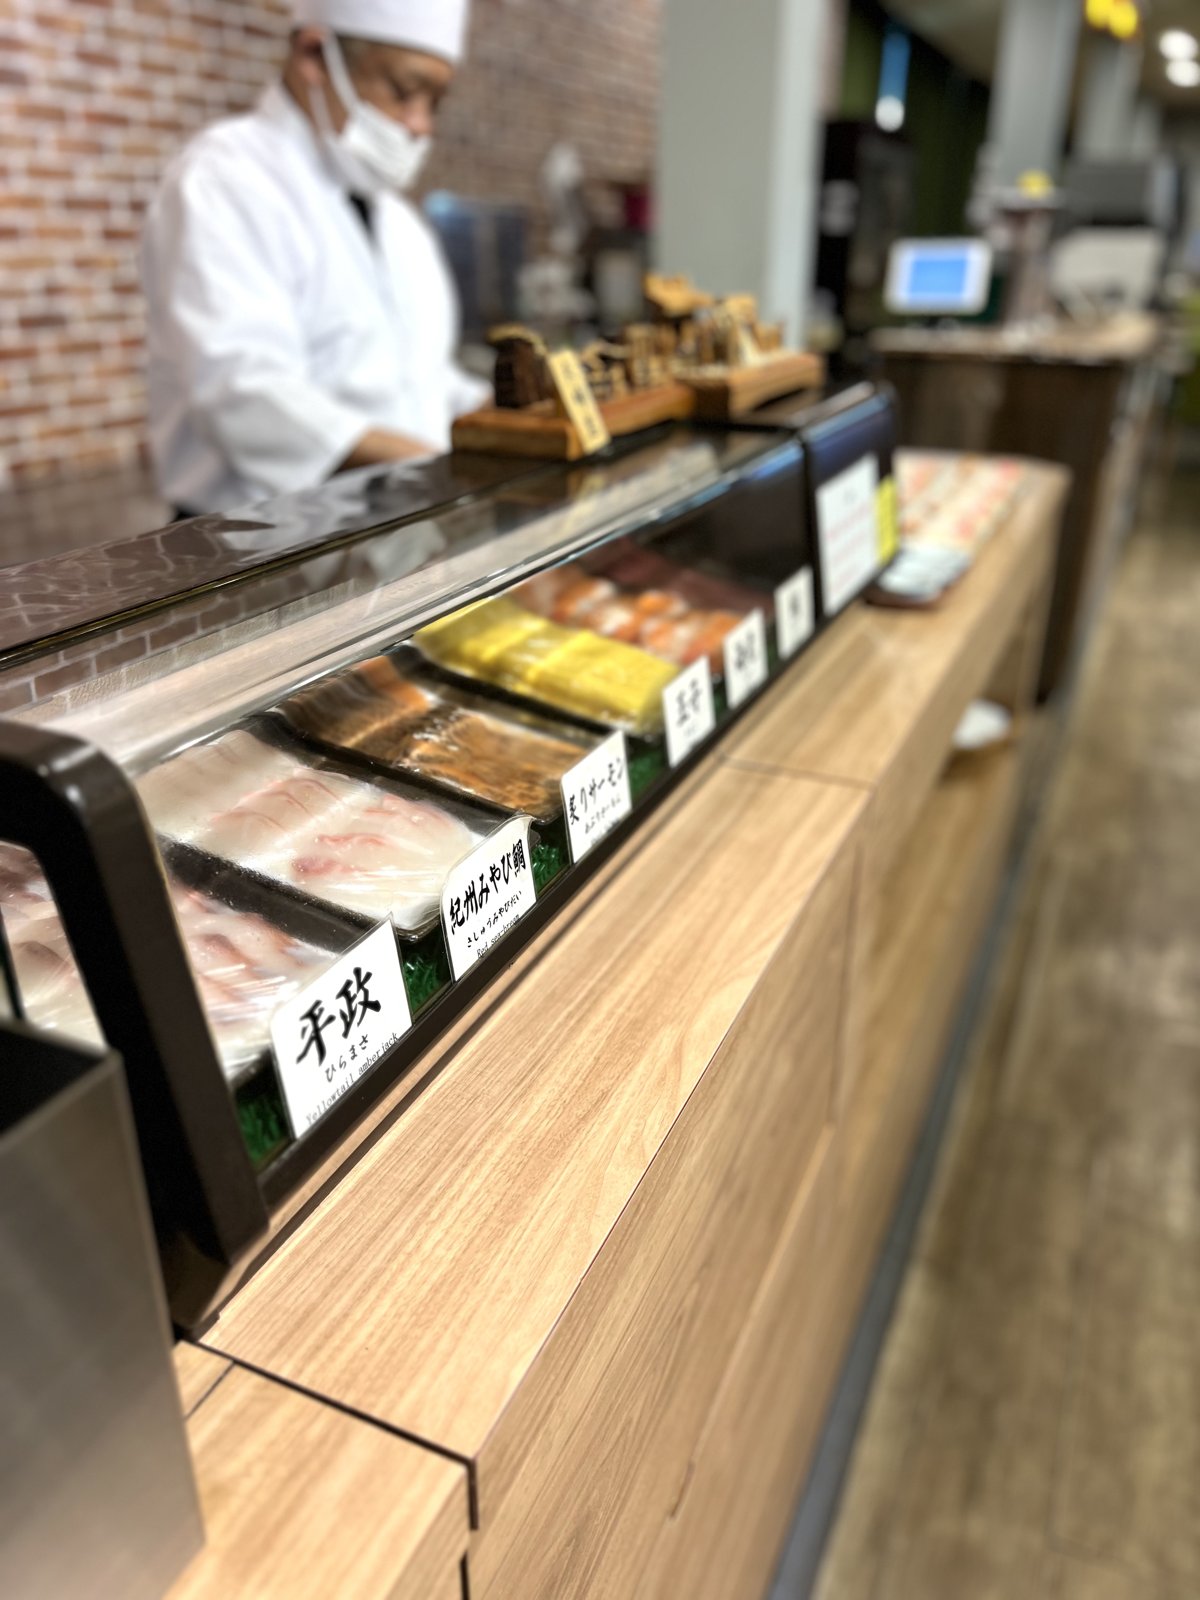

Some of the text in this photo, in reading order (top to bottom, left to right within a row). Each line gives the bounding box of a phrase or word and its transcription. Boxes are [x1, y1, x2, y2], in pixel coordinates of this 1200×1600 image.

[450, 839, 526, 935] 紀州みやび鯛
[296, 967, 381, 1066] 平政
[325, 1034, 369, 1083] ひらまさ
[306, 1073, 355, 1126] Yellowtail
